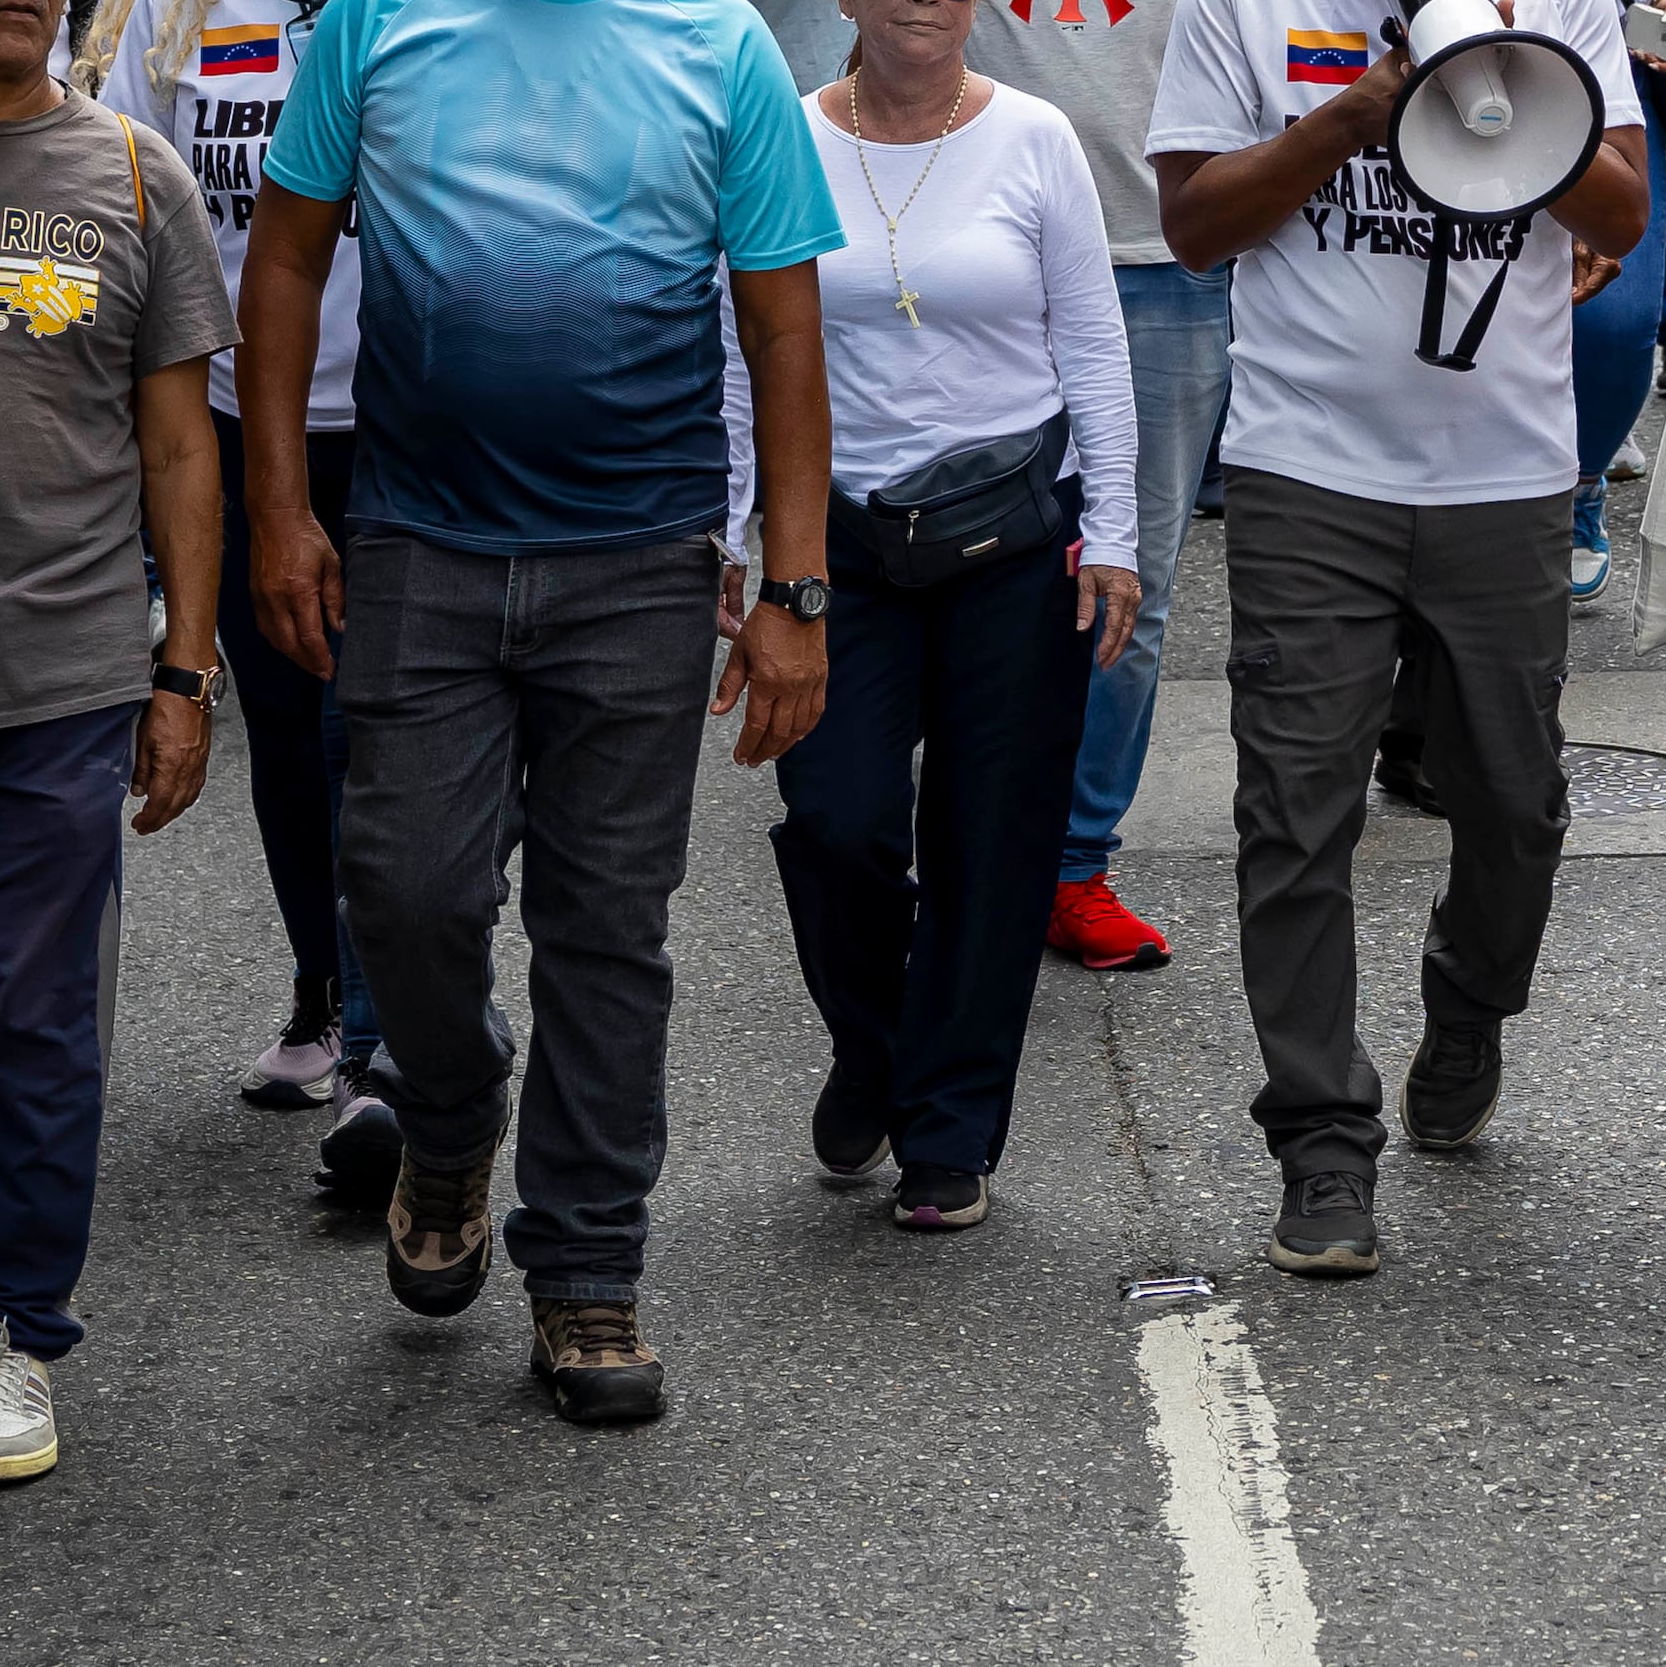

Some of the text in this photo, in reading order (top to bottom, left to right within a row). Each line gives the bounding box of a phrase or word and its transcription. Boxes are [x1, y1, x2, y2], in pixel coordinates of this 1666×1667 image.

[192, 143, 253, 191] PARA
[1363, 165, 1408, 212] LOS
[0, 206, 105, 264] RICO
[1302, 206, 1532, 262] Y PENSONES
